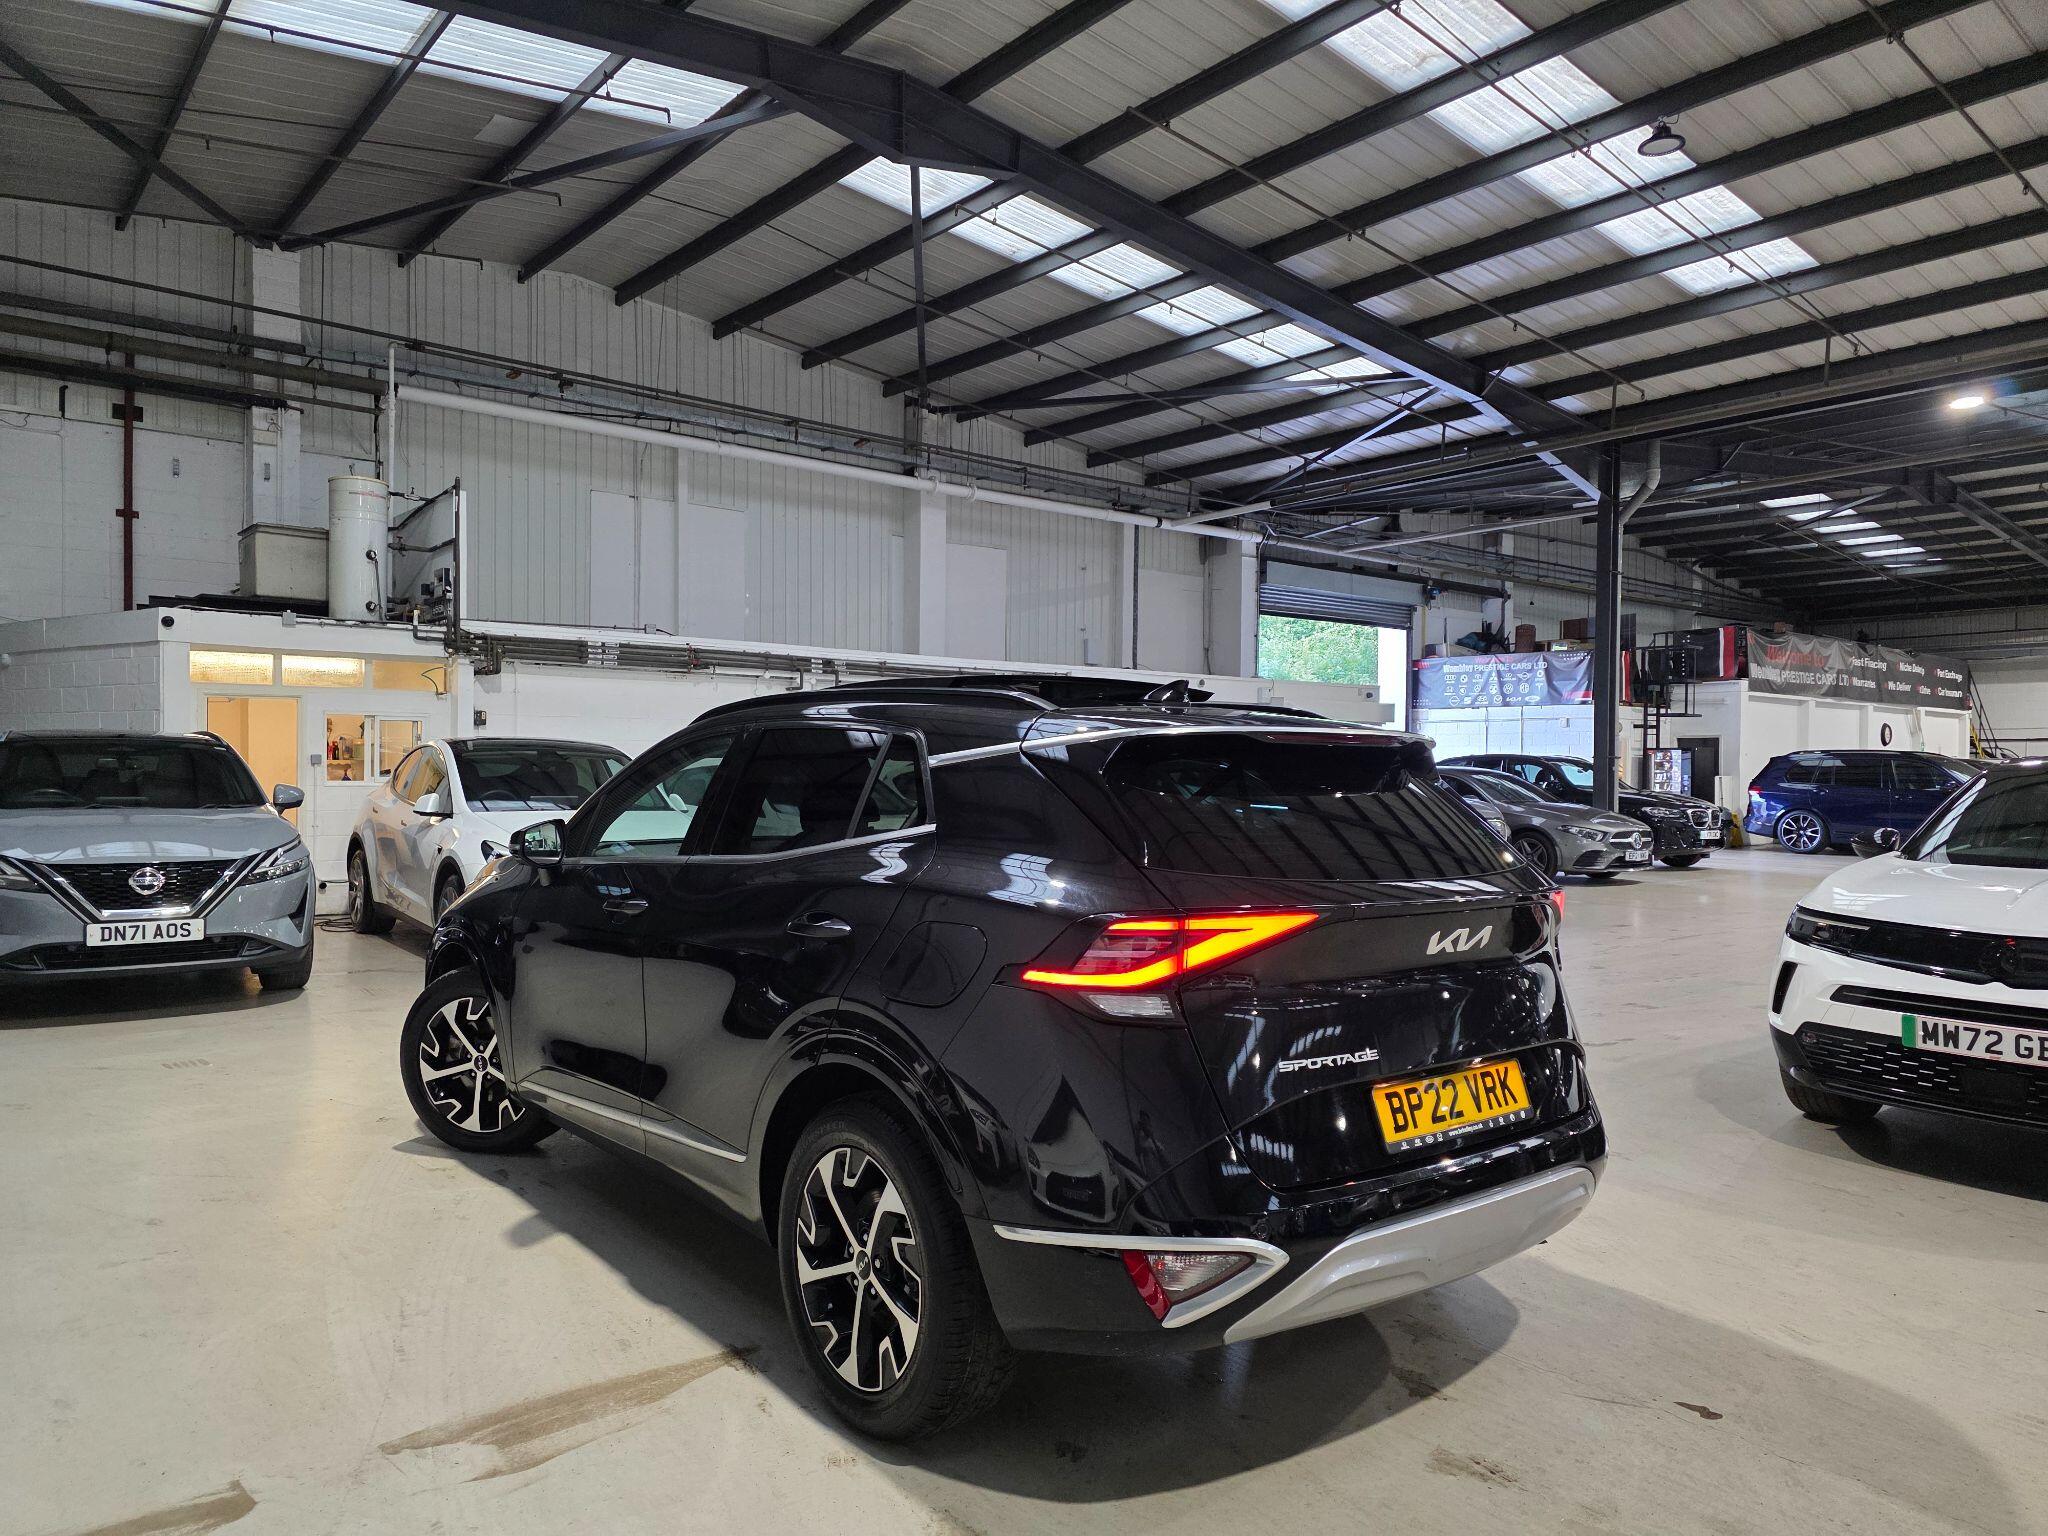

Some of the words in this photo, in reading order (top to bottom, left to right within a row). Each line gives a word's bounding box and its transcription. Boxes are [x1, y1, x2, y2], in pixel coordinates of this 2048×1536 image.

[1474, 663, 1509, 671] PRESTIGE
[1511, 662, 1532, 670] CARS
[1533, 661, 1548, 670] LTD
[100, 924, 146, 942] DN71
[153, 922, 191, 940] AOS
[1426, 925, 1493, 955] KIA
[1921, 1020, 2004, 1056] MW72
[1279, 1048, 1379, 1073] SPORTAGE
[1384, 1078, 1464, 1134] BP22
[1463, 1066, 1519, 1114] VRK
